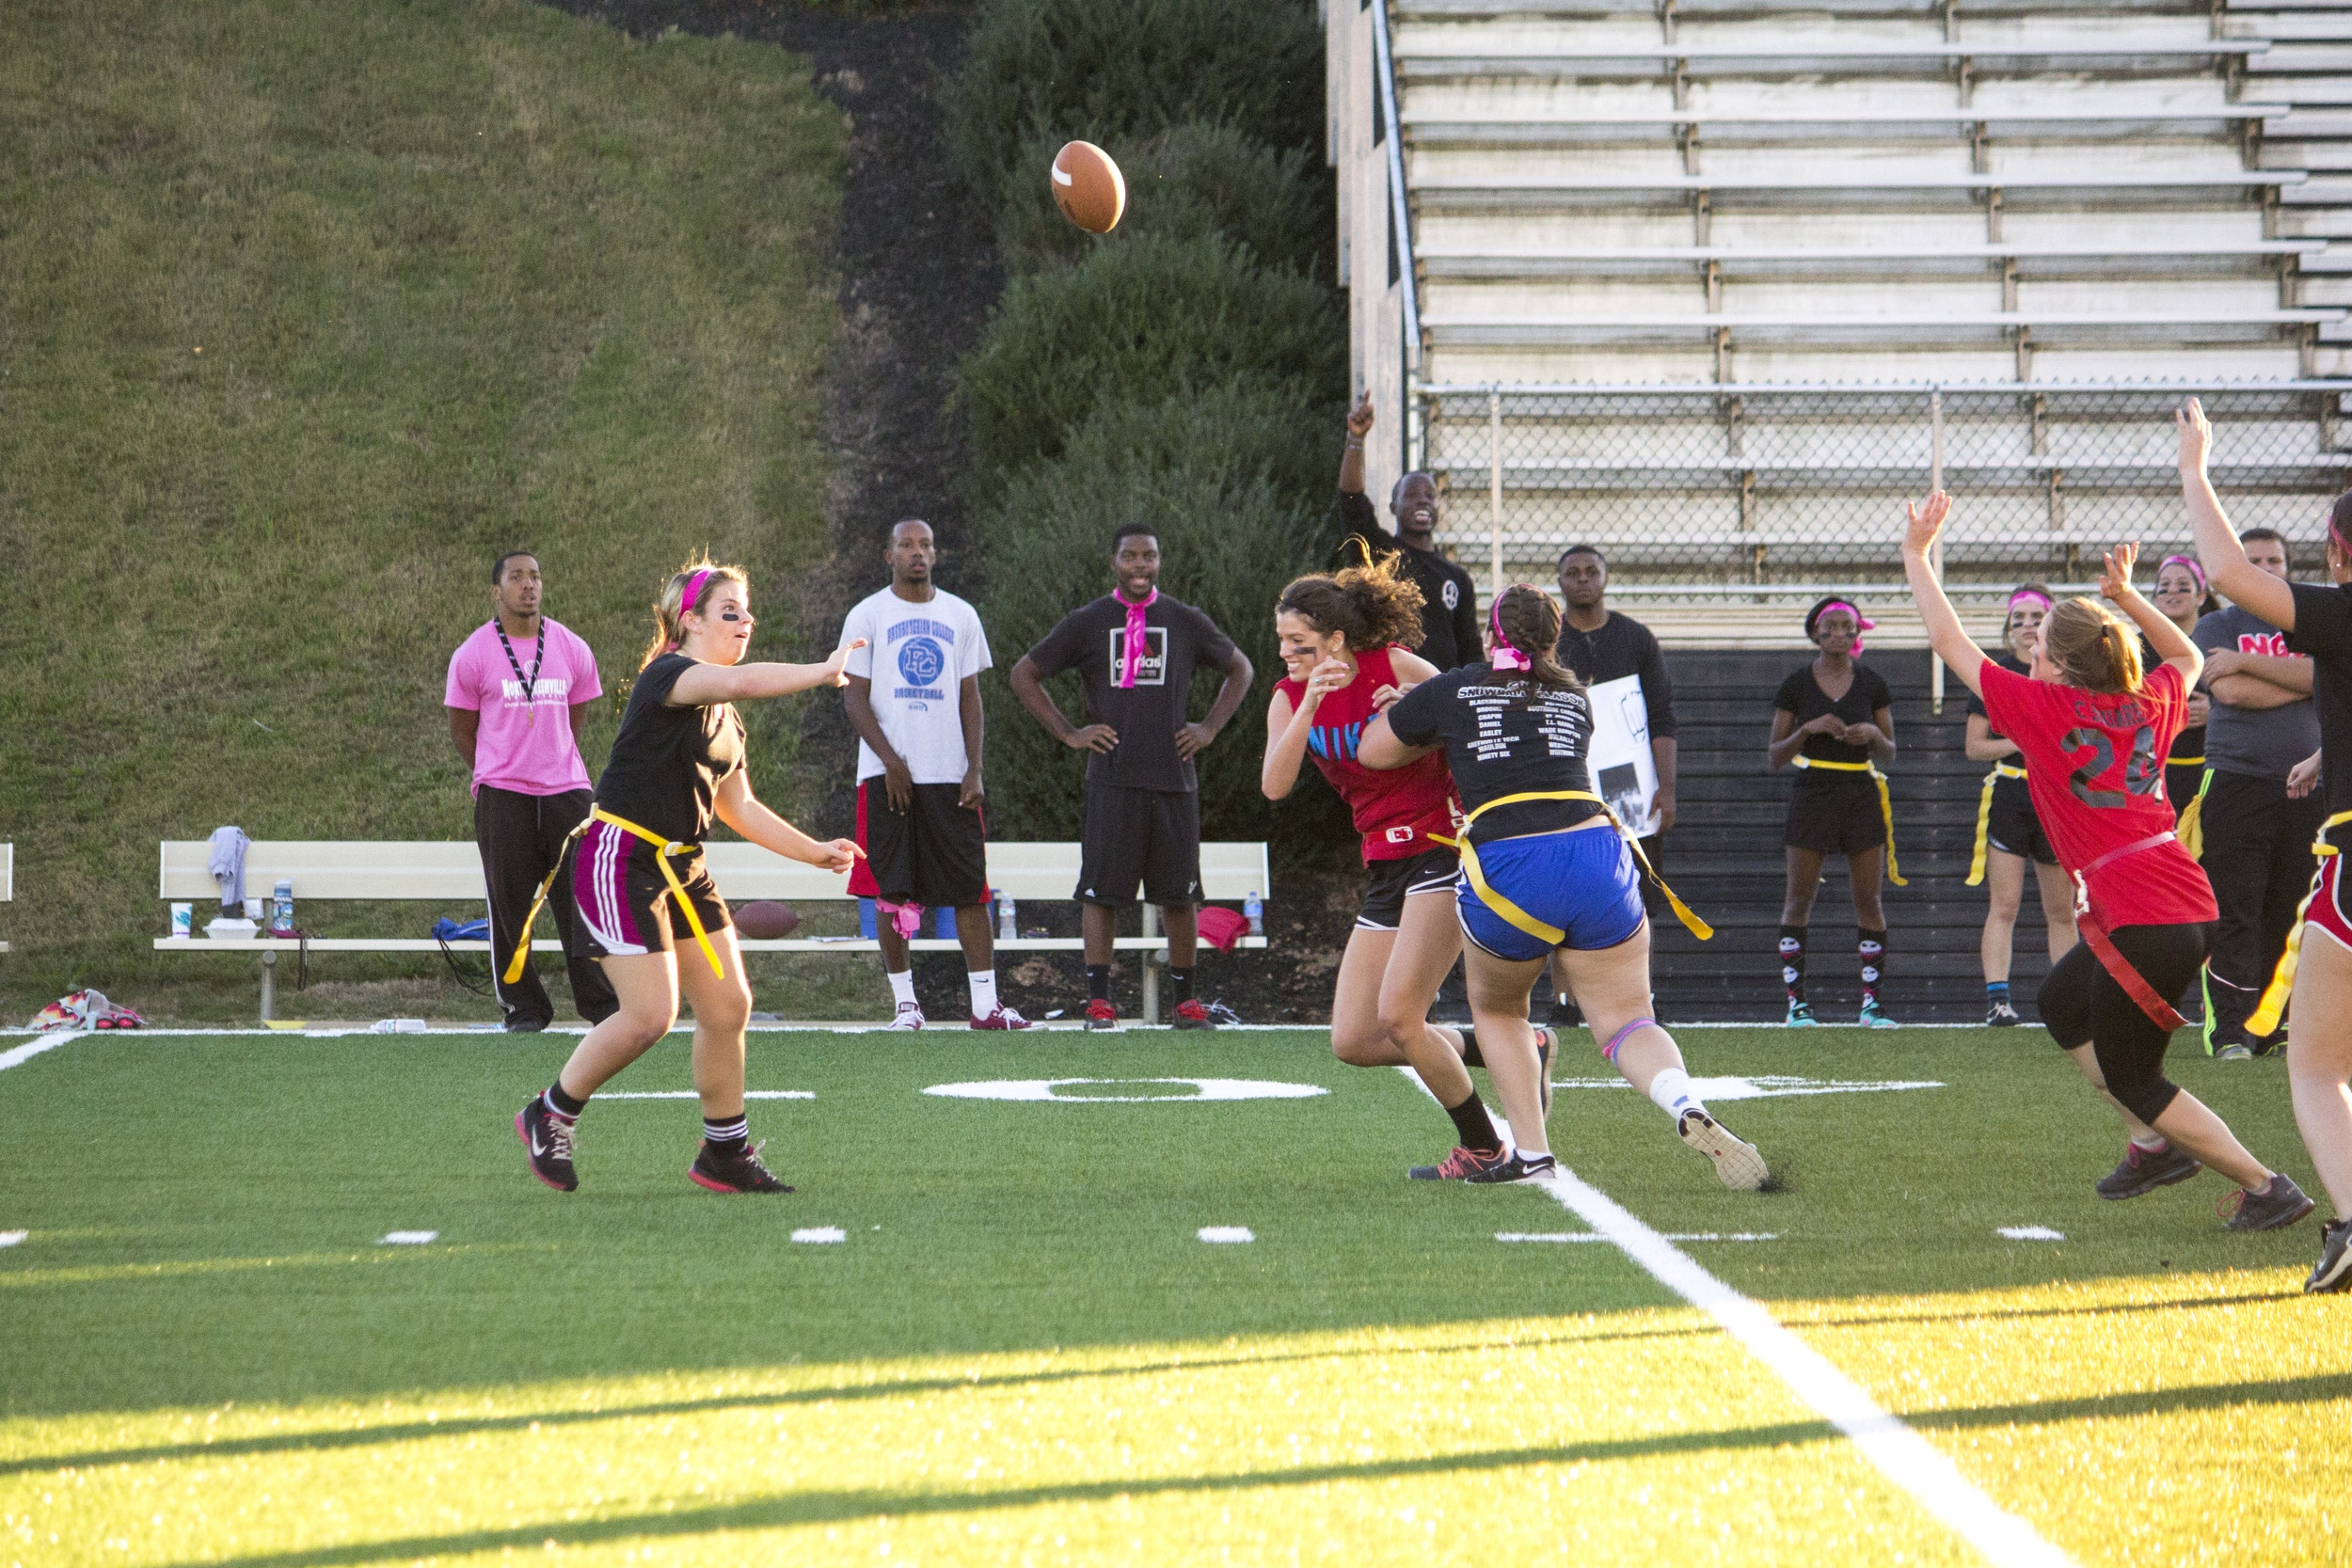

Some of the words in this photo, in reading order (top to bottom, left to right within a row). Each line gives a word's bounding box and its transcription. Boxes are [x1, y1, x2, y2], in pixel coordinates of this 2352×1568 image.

[2237, 632, 2304, 657] NG
[1116, 655, 1161, 668] adas
[894, 689, 944, 701] BASKETBALL
[1307, 712, 1380, 763] NIK
[1480, 729, 1502, 737] EASLEY
[1478, 742, 1507, 752] MAULDIN
[1477, 752, 1498, 761] NINETY
[2060, 724, 2164, 809] 24
